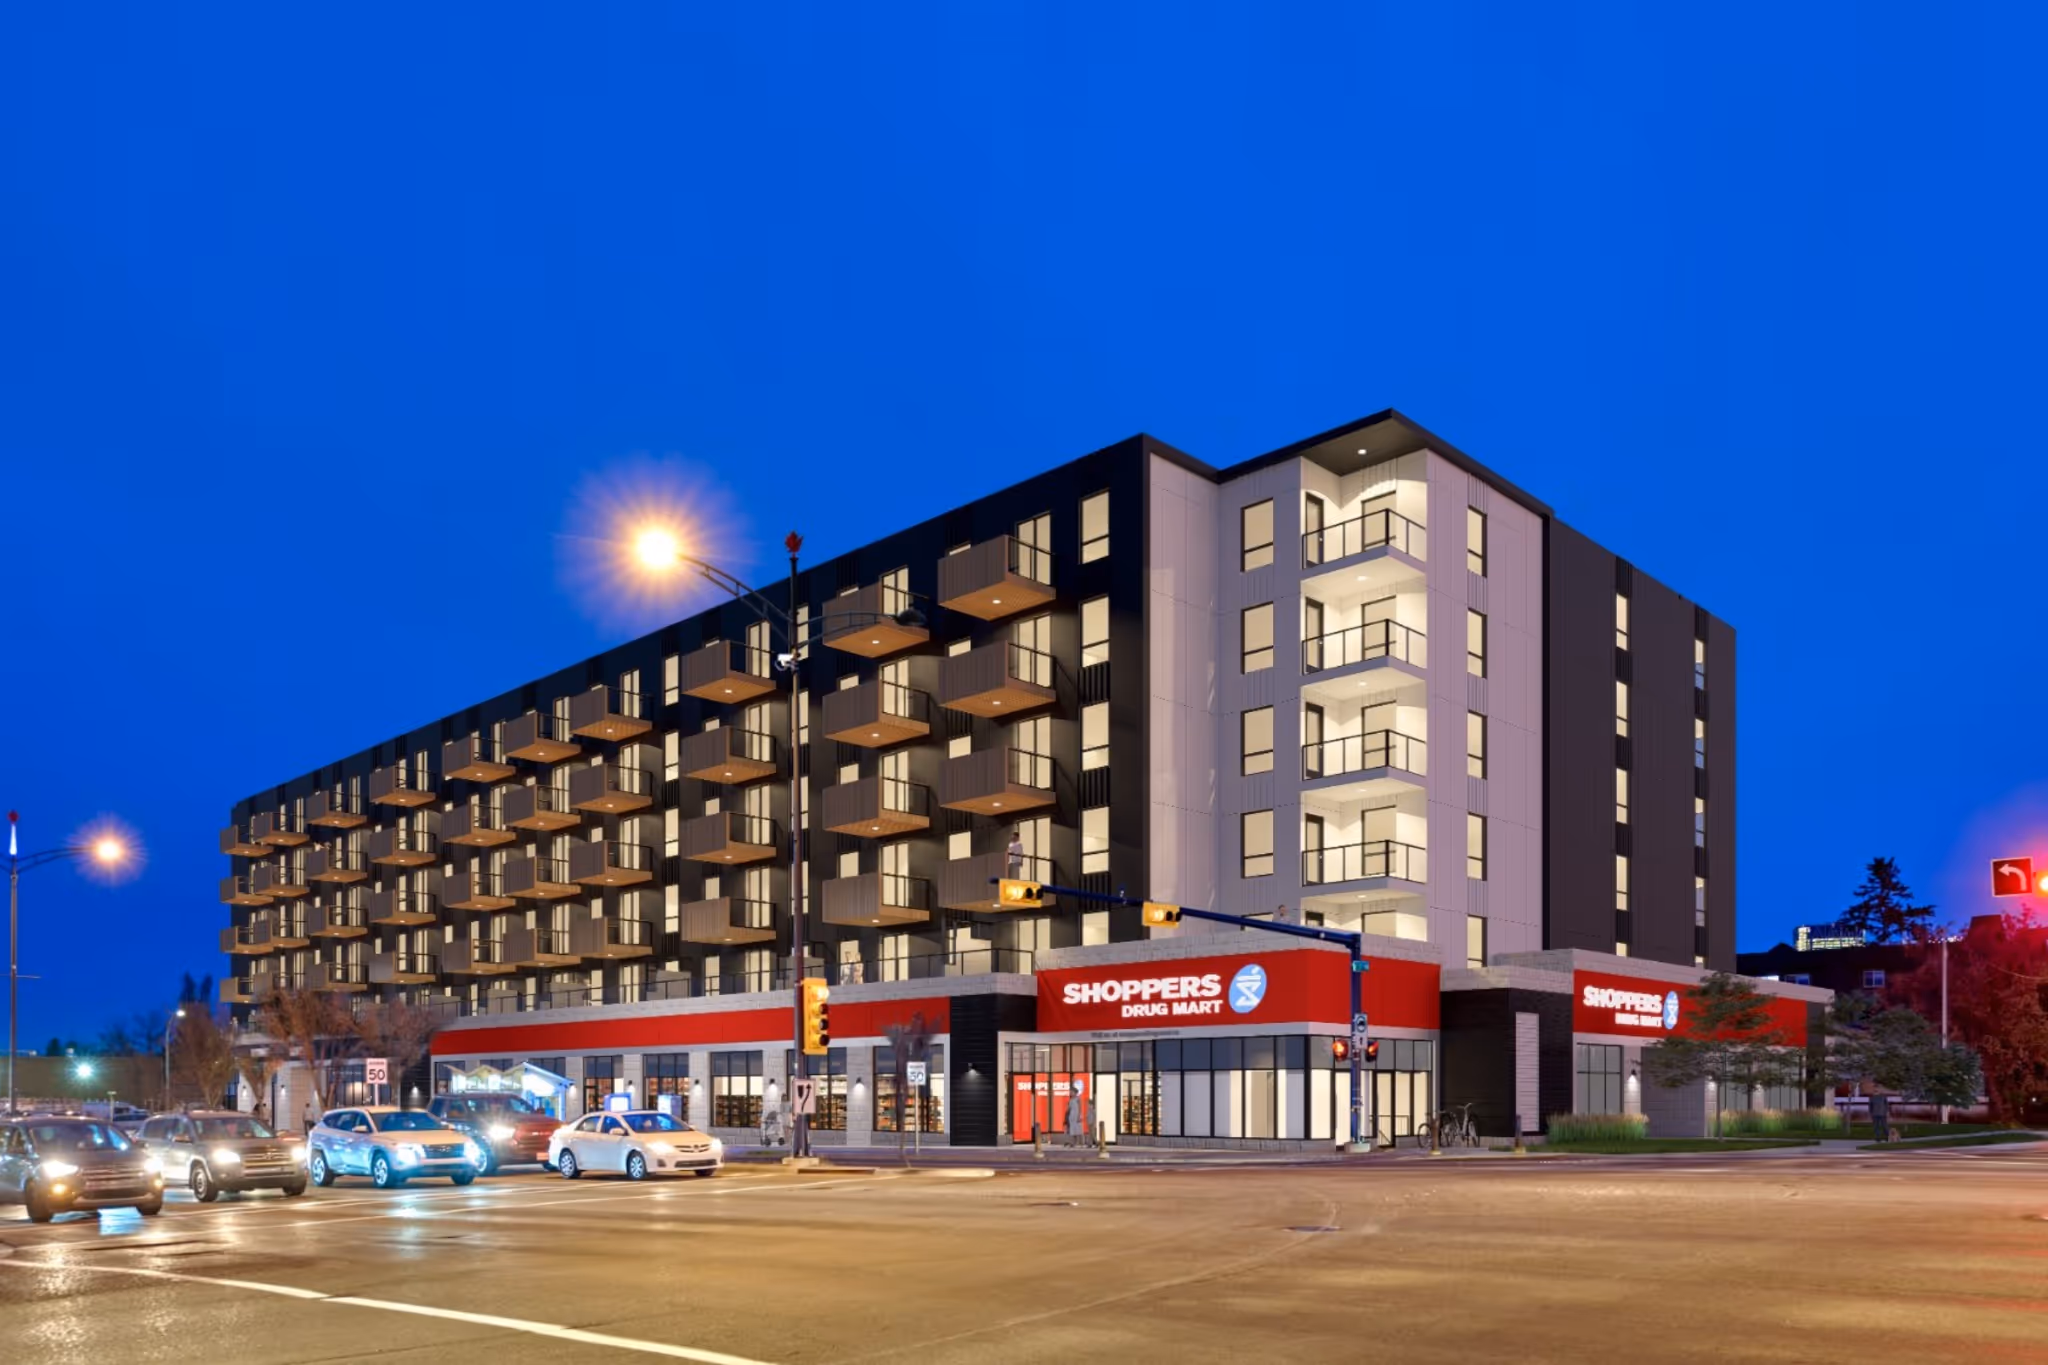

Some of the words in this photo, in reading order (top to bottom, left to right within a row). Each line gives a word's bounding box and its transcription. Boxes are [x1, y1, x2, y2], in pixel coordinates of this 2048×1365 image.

[1063, 974, 1221, 1004] SHOPPERS
[1121, 1003, 1168, 1018] DRUG
[1172, 999, 1223, 1015] MART
[1583, 985, 1662, 1014] SHOPPERS
[369, 1069, 385, 1081] 50
[910, 1071, 923, 1082] 50
